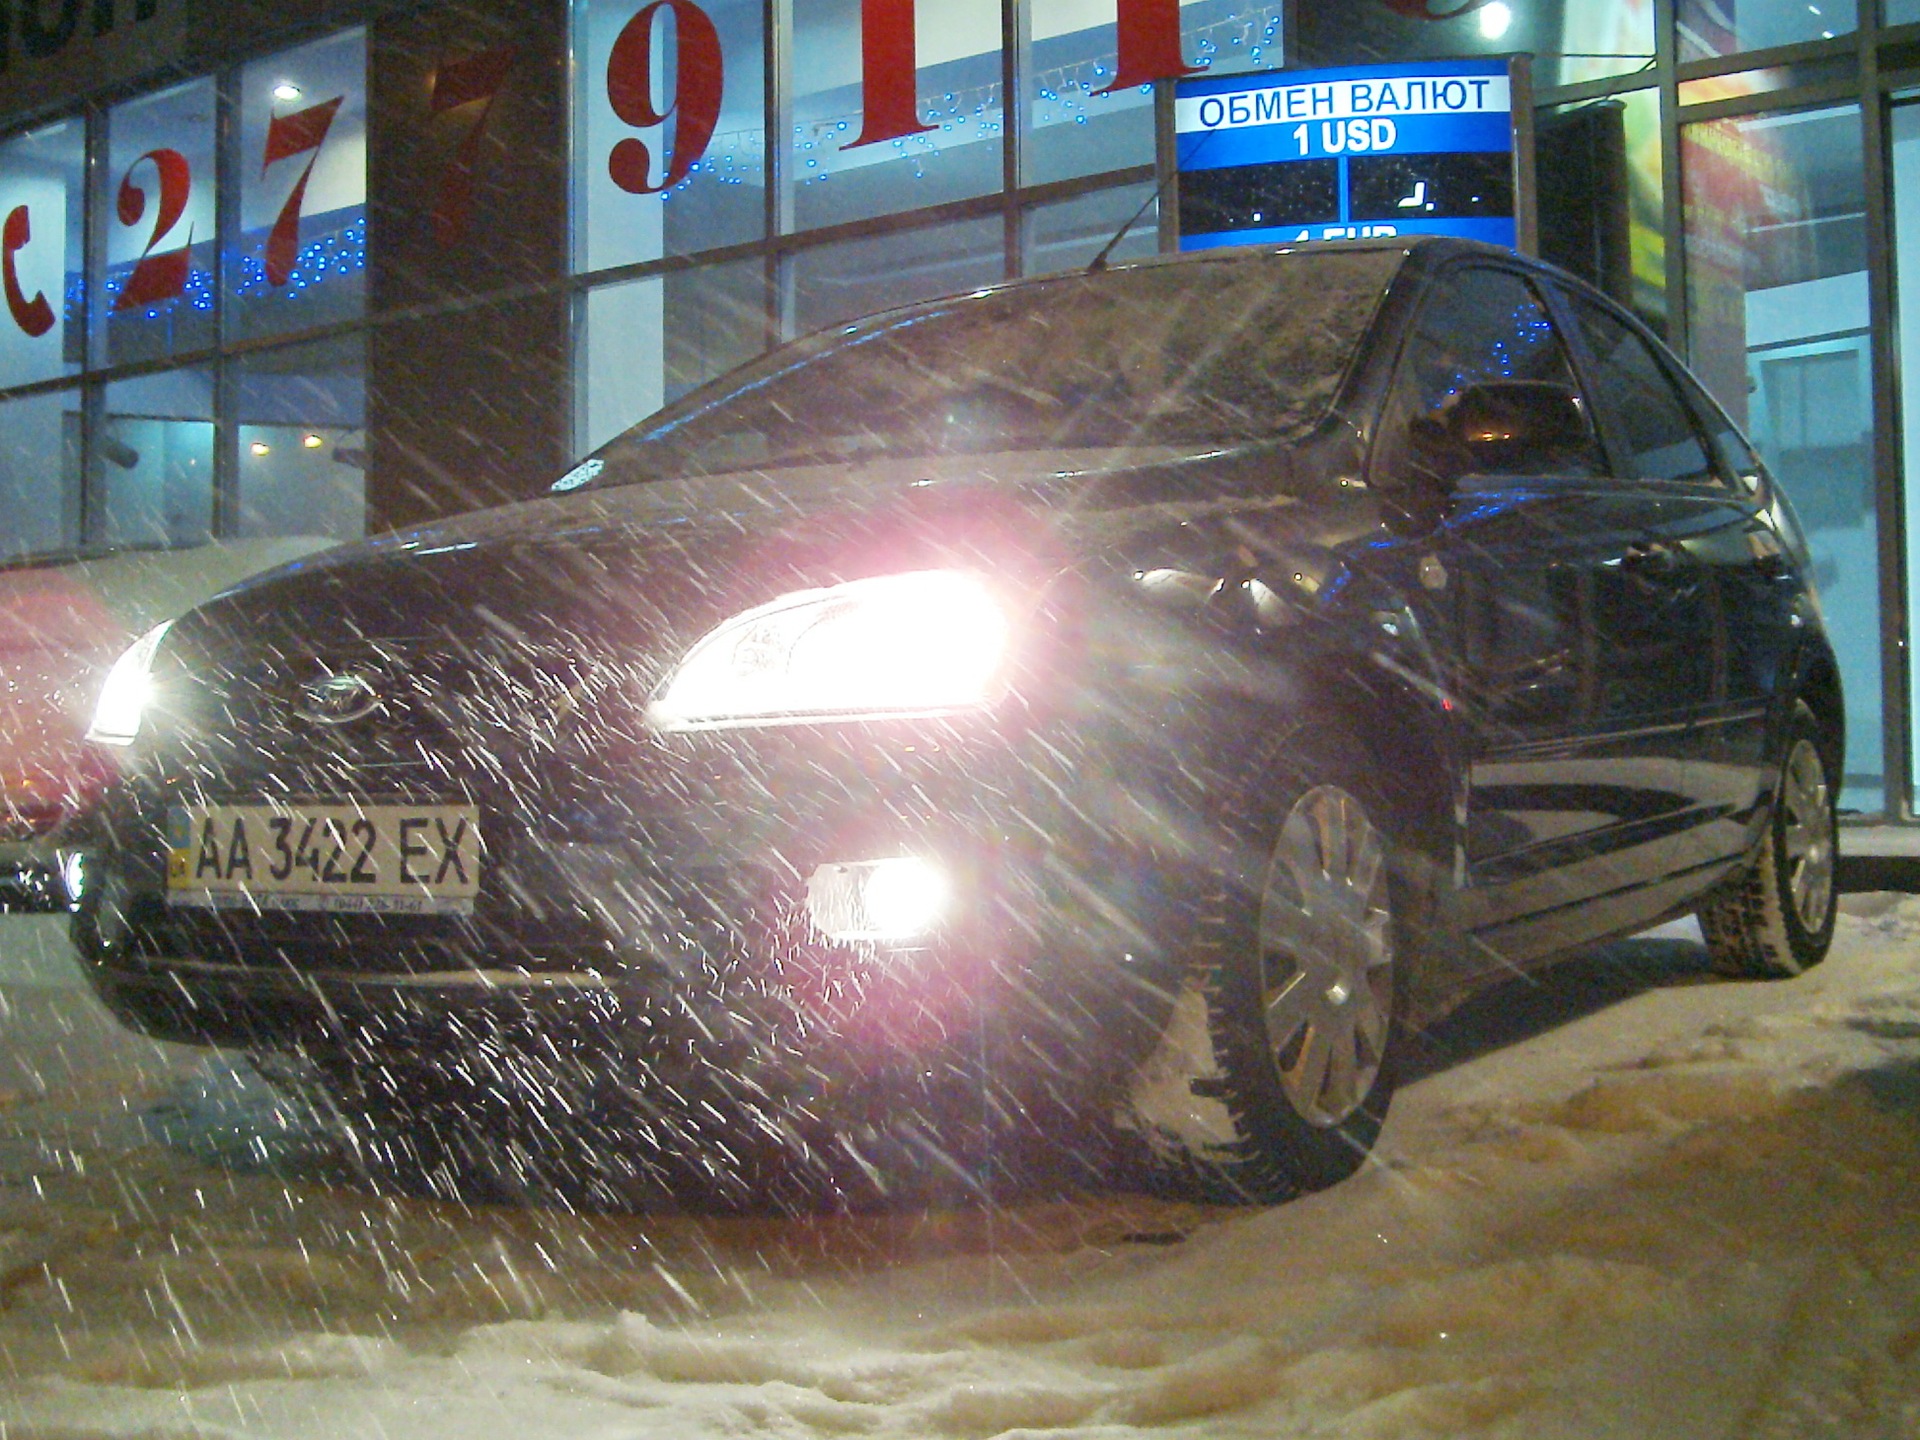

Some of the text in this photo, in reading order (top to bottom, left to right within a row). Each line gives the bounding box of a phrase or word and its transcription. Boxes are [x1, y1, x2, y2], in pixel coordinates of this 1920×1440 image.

[607, 0, 723, 194] 9
[1199, 80, 1490, 128] ОБМЕН ВАЛЮТ
[1293, 118, 1398, 156] 1 USD
[196, 817, 470, 885] AA 3422 EX
